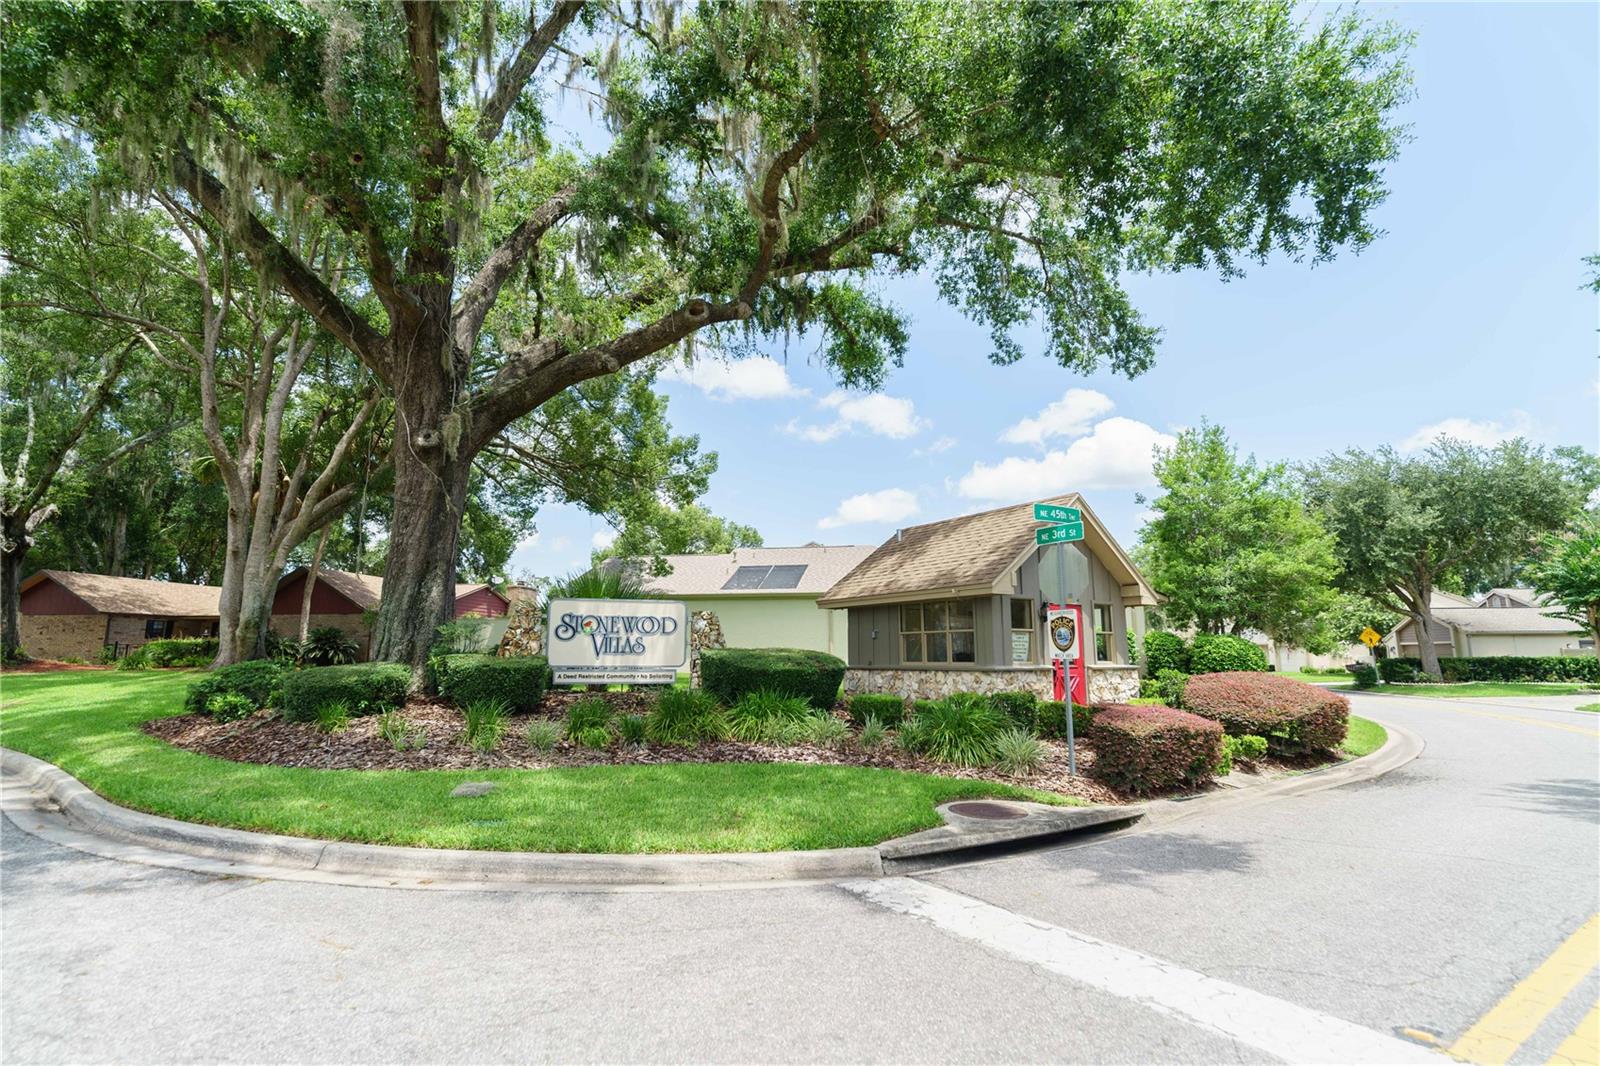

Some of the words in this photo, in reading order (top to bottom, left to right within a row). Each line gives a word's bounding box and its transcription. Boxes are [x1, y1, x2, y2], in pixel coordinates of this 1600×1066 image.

[1050, 510, 1067, 519] 45th
[1052, 530, 1066, 539] 3rd
[555, 612, 677, 640] STONEWOOD
[1051, 617, 1073, 629] POLICE
[592, 634, 645, 657] VILLAS
